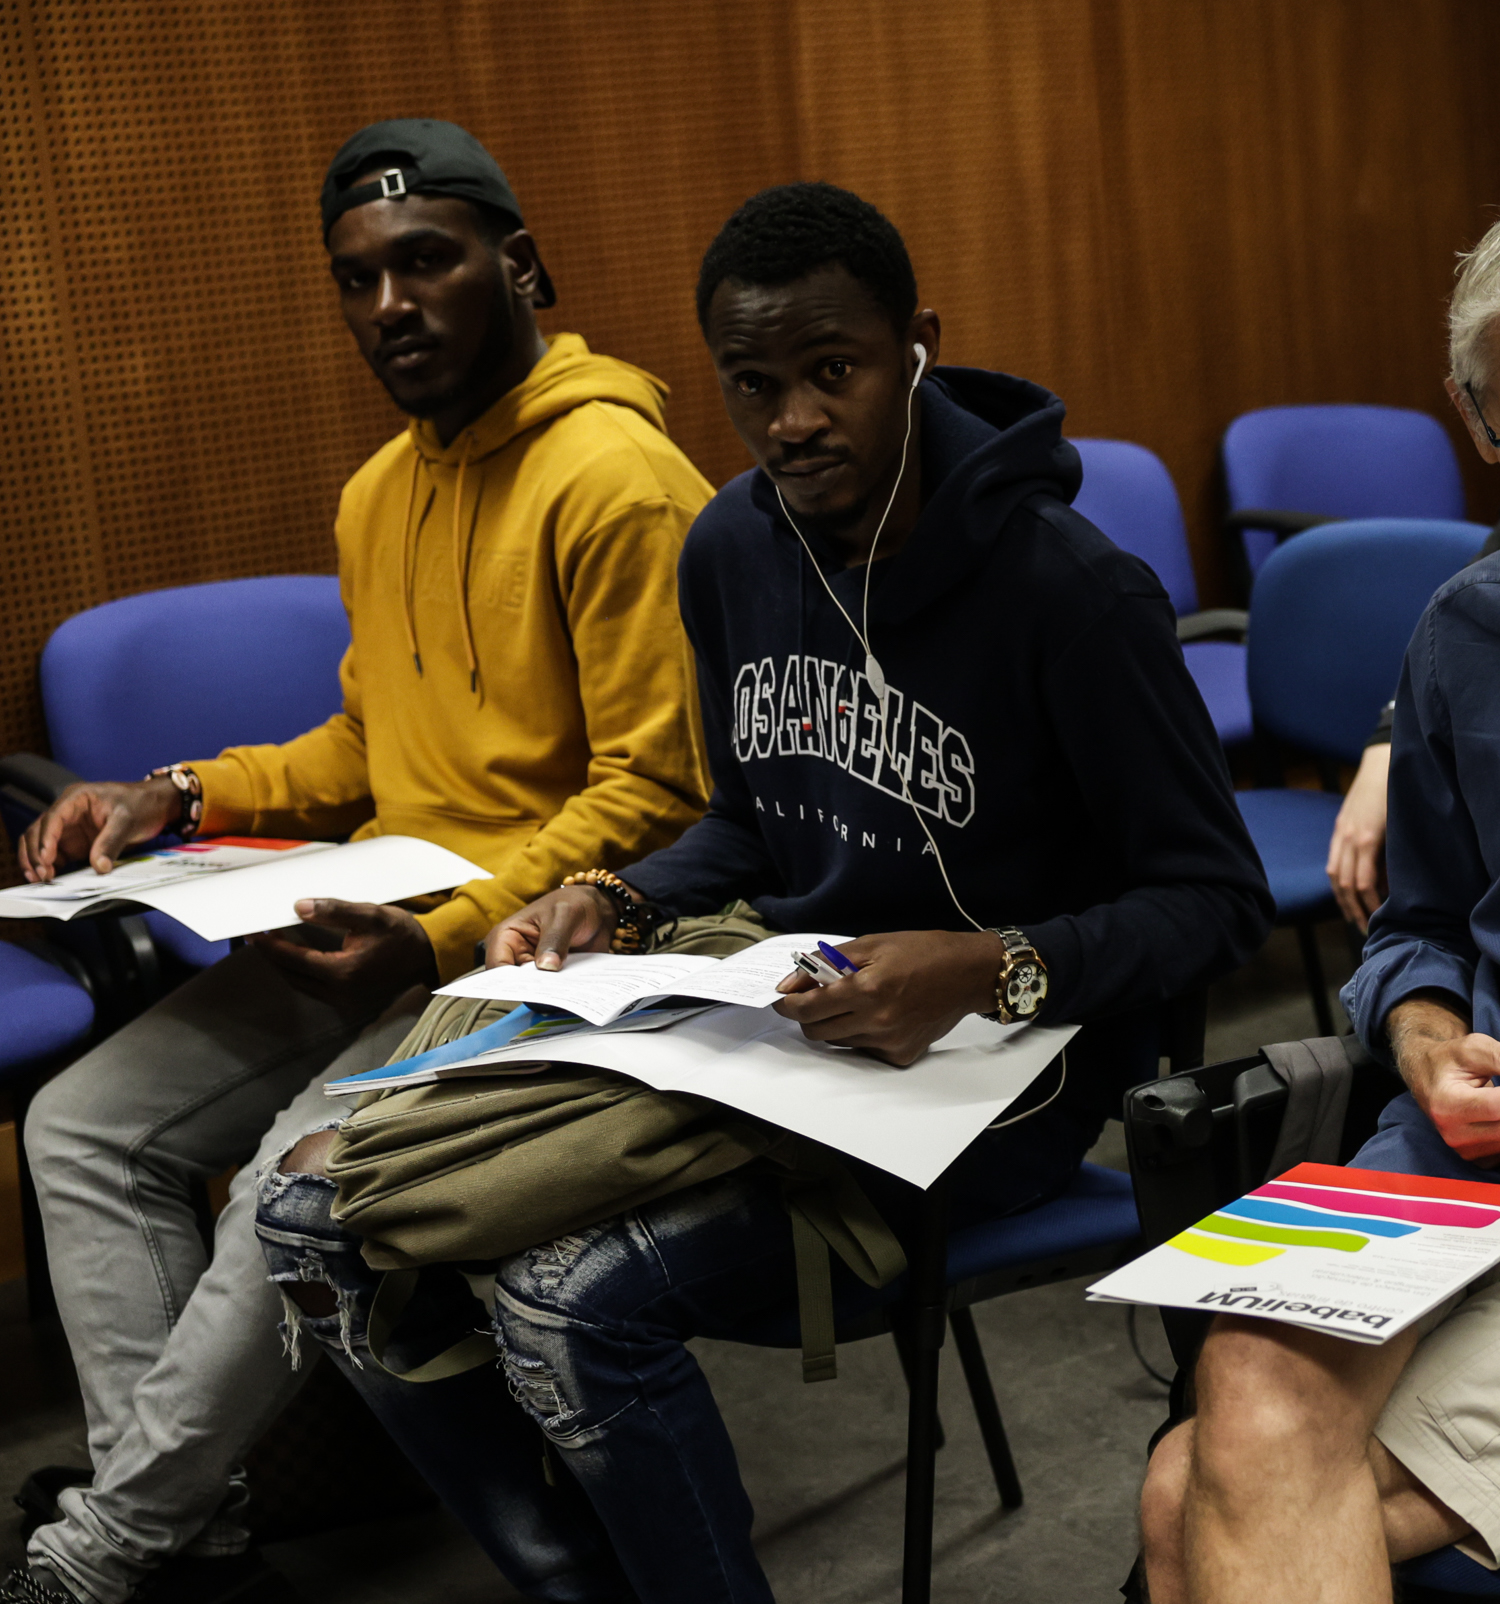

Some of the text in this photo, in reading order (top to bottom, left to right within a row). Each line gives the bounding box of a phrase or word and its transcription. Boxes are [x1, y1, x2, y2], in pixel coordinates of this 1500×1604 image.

[731, 653, 975, 828] OS ANGELES
[755, 796, 936, 855] ALIFORNIA
[1195, 1291, 1395, 1330] babeliUM
[1334, 1298, 1354, 1308] de
[1357, 1302, 1405, 1315] centro
